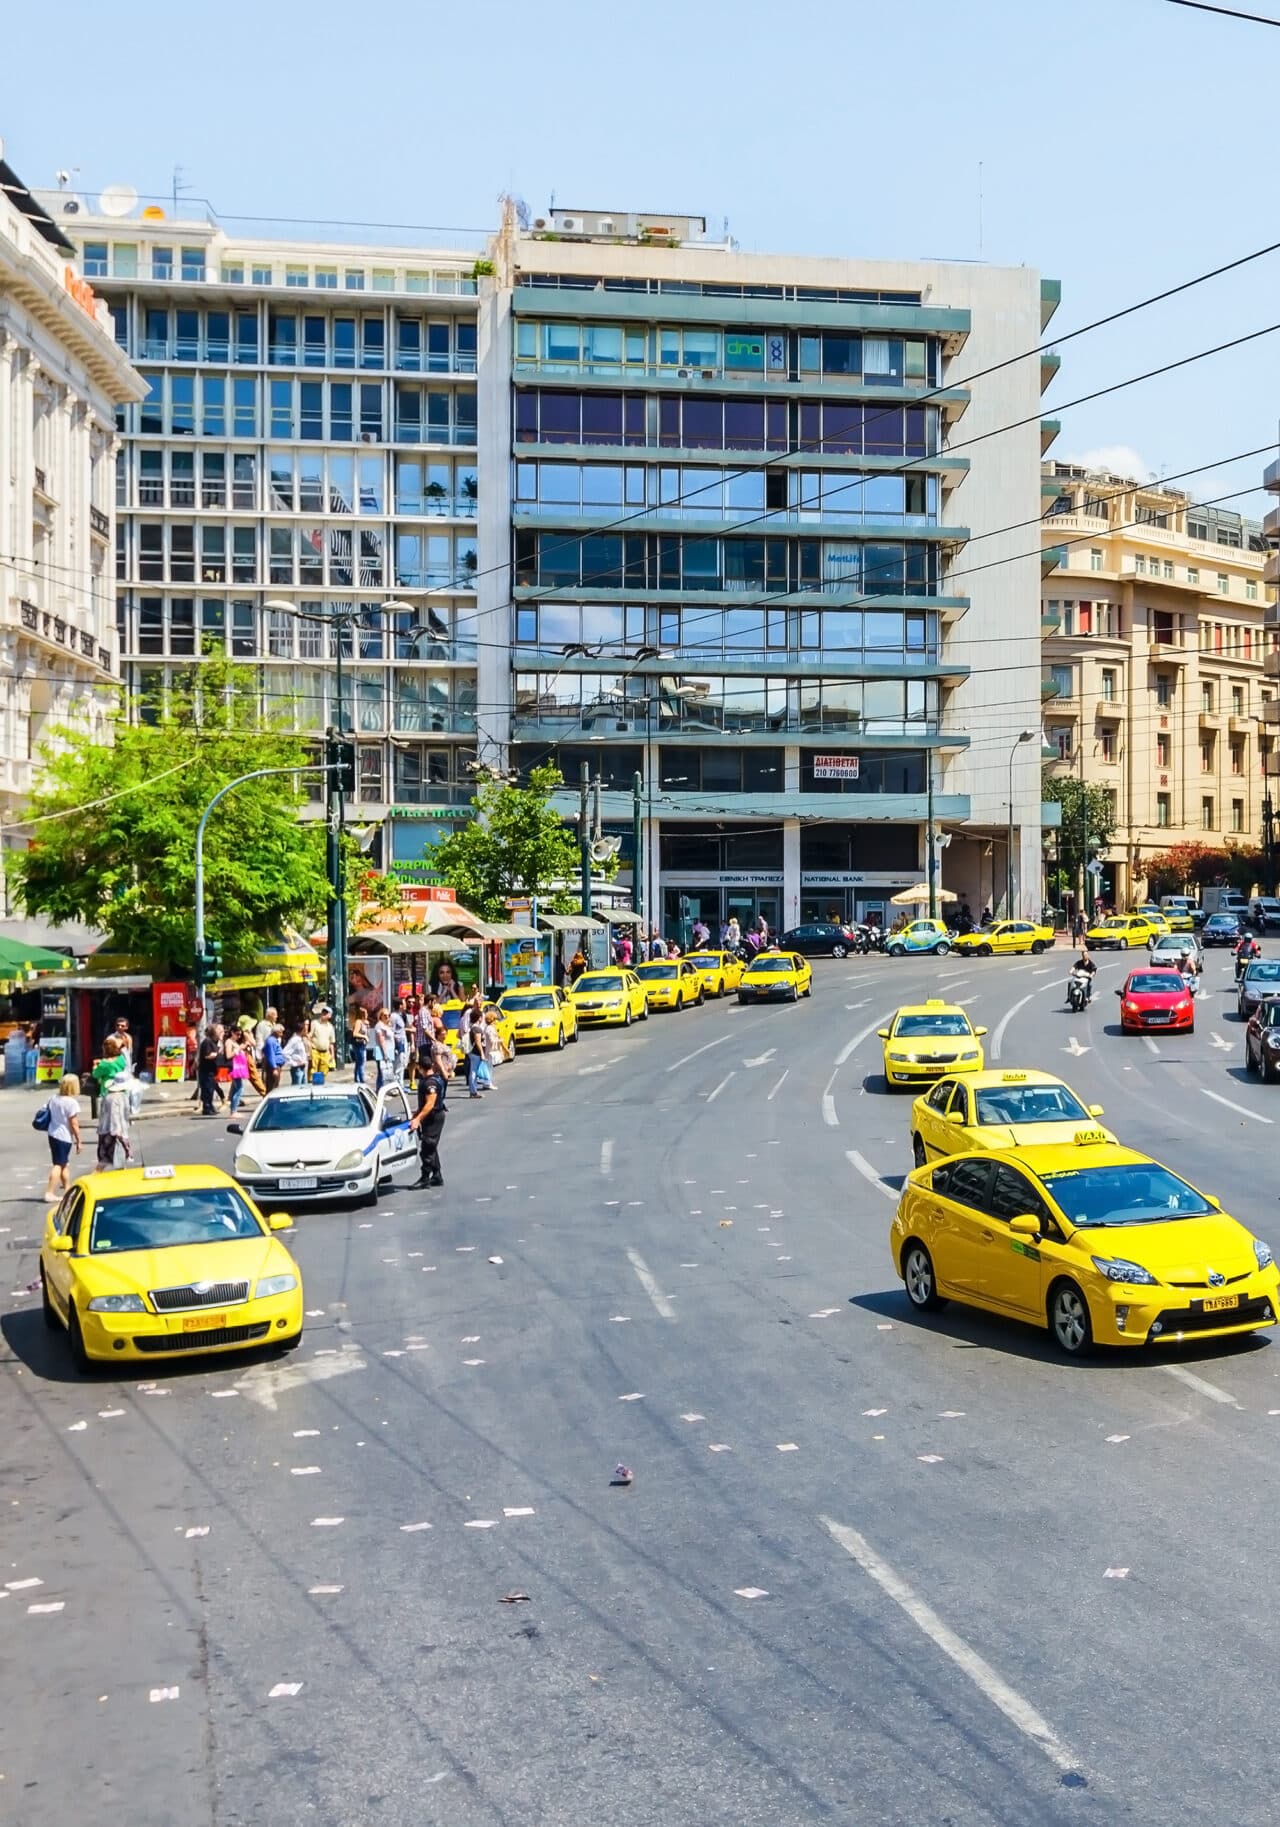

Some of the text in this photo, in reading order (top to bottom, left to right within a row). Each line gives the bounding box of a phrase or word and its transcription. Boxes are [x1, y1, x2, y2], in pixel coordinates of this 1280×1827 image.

[727, 341, 762, 355] dna
[815, 769, 827, 777] 210
[391, 806, 477, 818] Pharmacy
[719, 875, 749, 883] ΕΘΝΙΚΗ
[803, 875, 864, 883] NATIONAL BANK
[567, 928, 605, 937] MAGO
